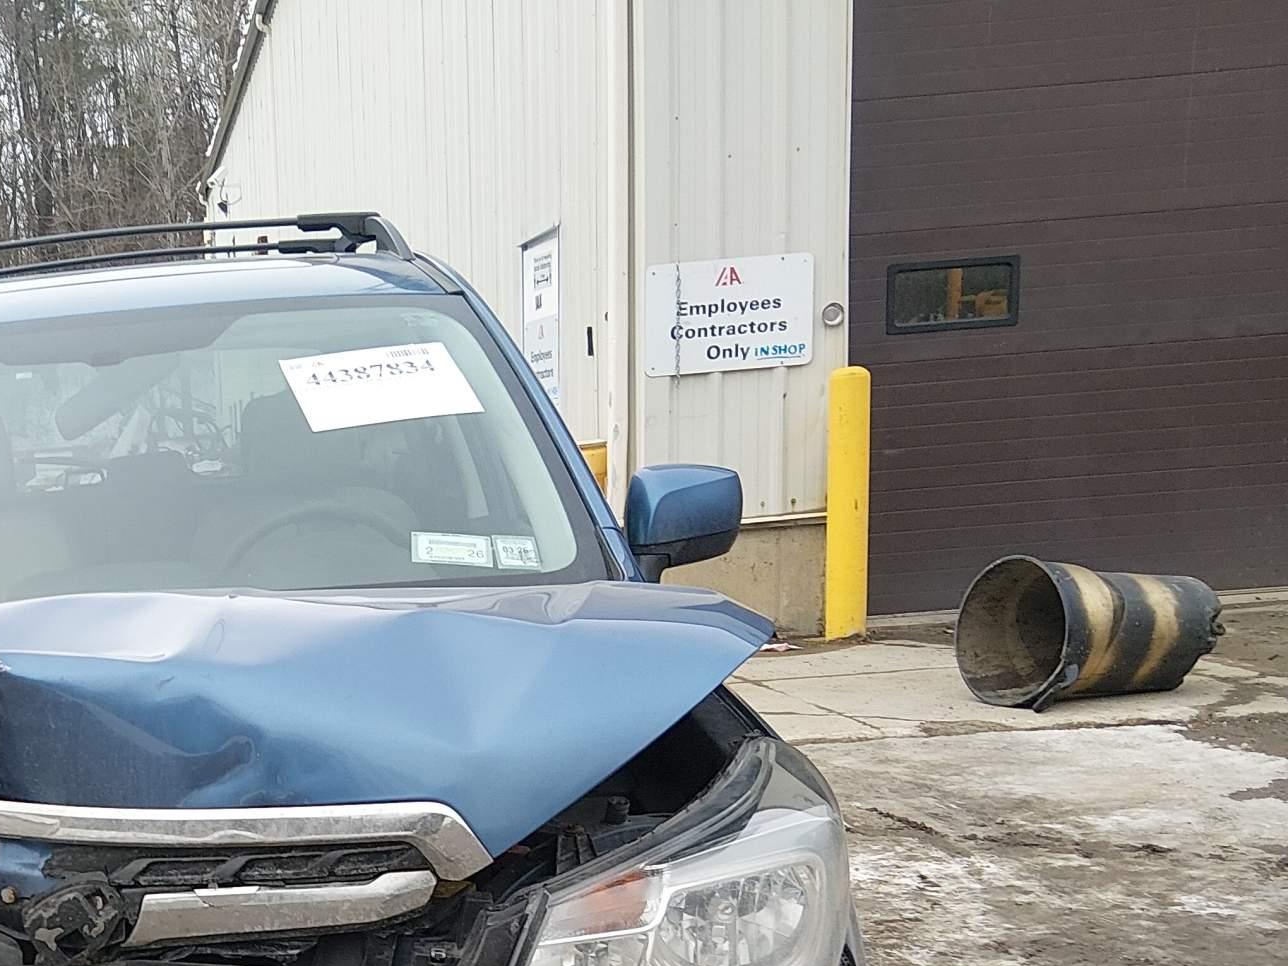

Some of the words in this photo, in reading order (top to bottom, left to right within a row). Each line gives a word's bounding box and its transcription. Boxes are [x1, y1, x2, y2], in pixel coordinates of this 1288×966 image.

[677, 297, 782, 318] Employees
[670, 319, 788, 341] Contractors
[706, 343, 751, 361] Only
[306, 359, 435, 386] 44387834
